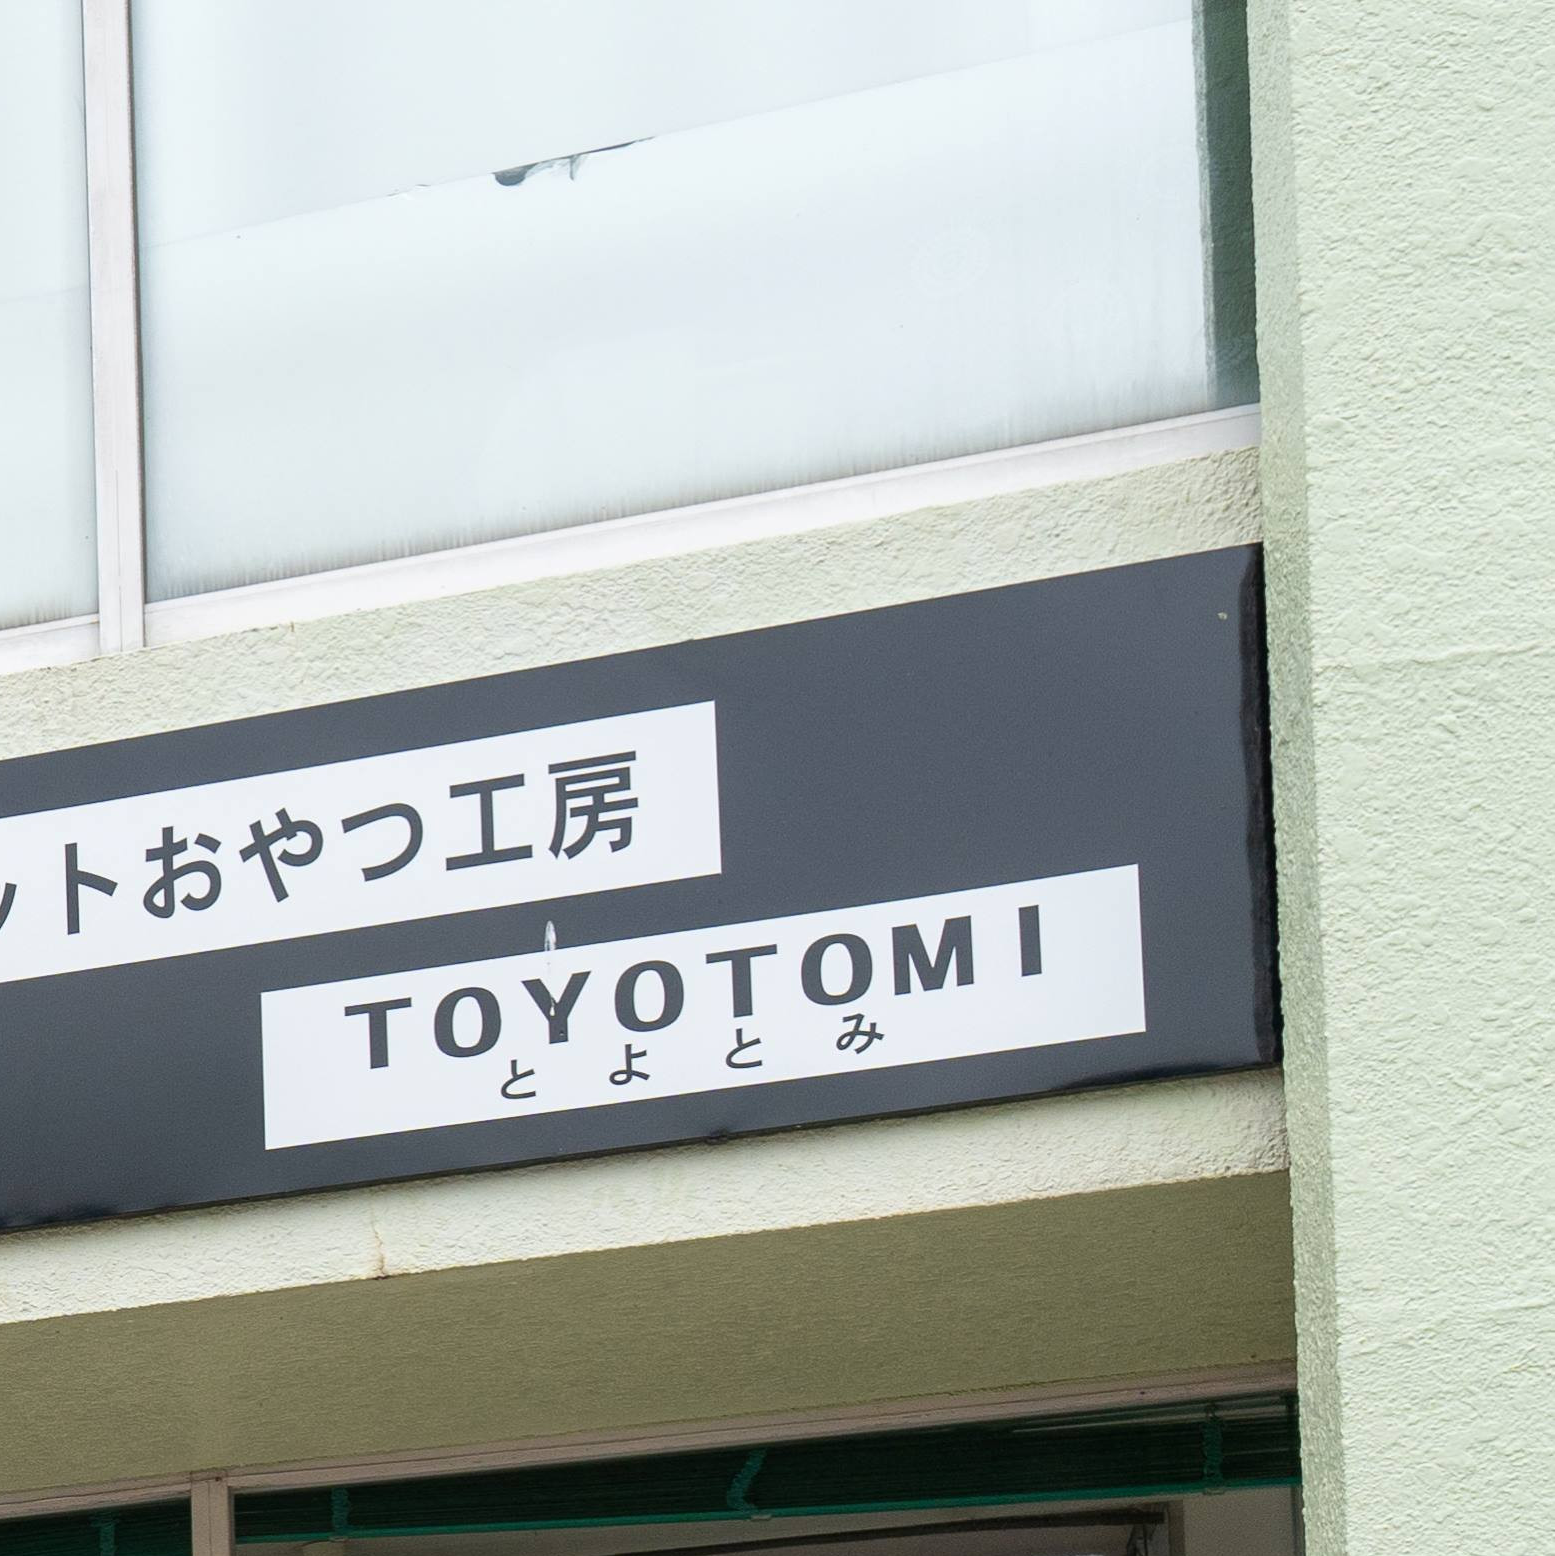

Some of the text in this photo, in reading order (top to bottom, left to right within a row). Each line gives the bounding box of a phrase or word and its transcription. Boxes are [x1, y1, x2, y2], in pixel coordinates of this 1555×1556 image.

[344, 905, 1044, 1070] TOYOTOMI
[501, 1013, 884, 1101] とよとみ
